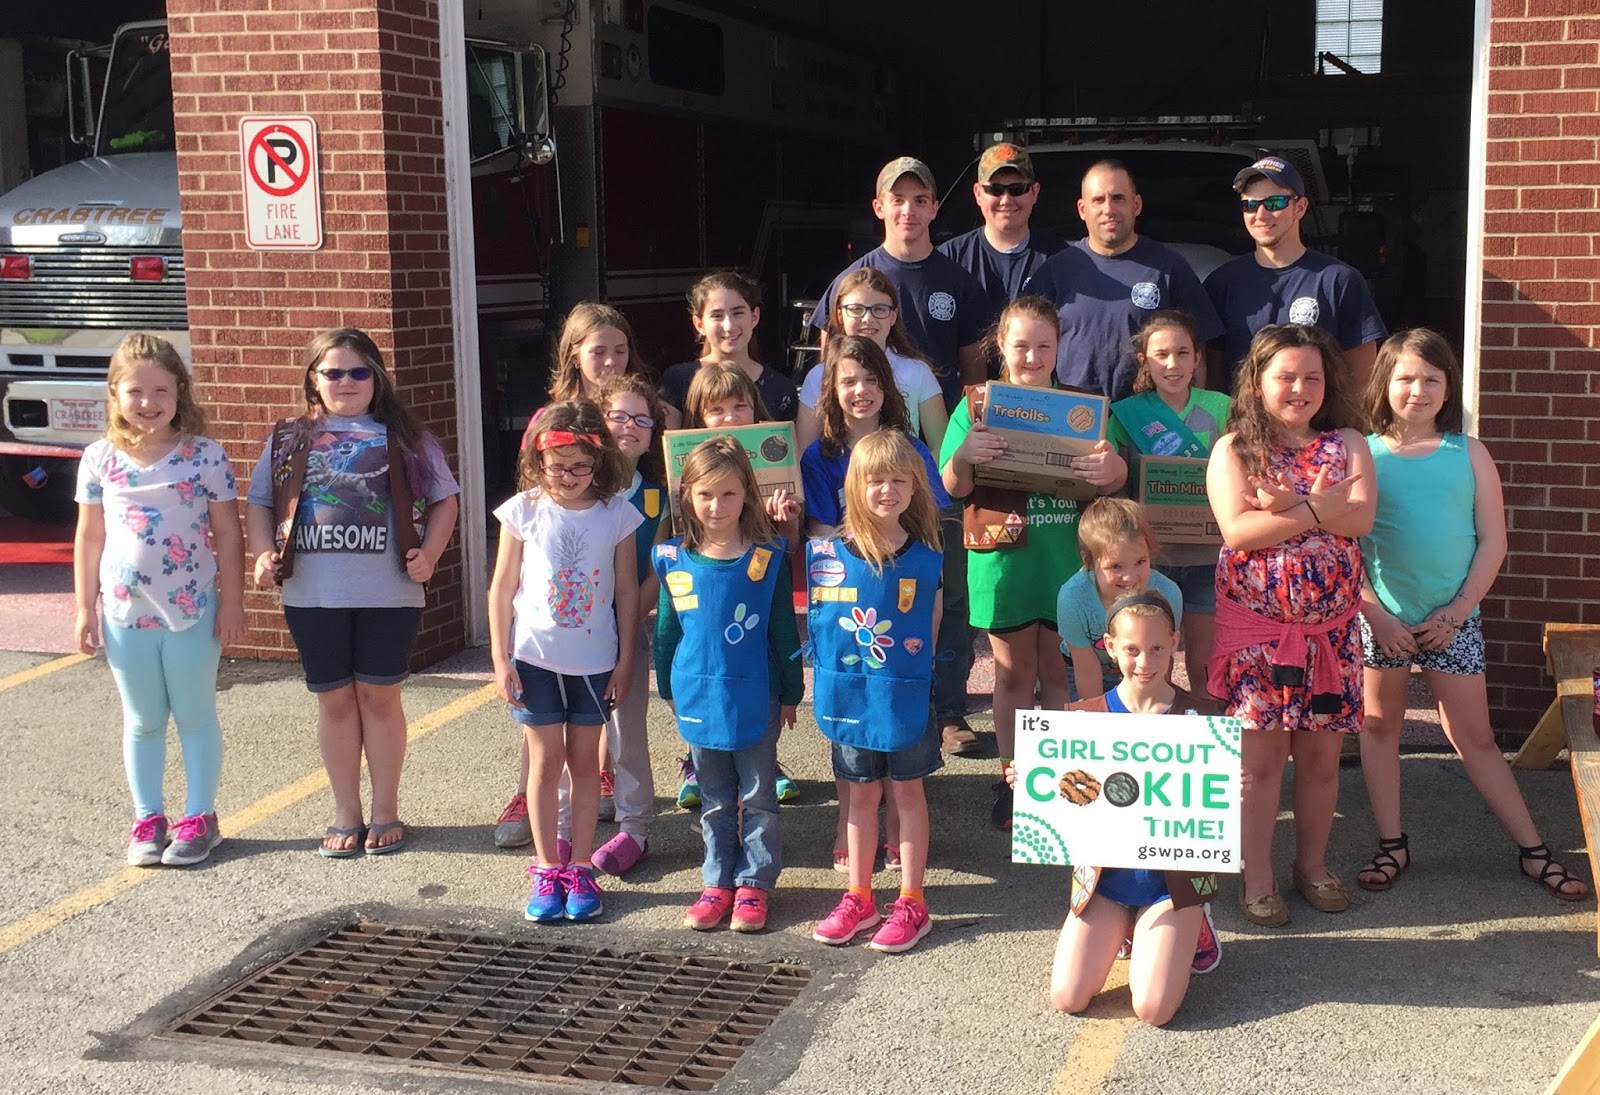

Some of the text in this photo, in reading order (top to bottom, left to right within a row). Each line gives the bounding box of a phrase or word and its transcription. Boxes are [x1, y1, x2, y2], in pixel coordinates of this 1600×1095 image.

[12, 207, 171, 225] CRABTREE
[266, 203, 298, 219] FIRE
[265, 224, 301, 240] LANE
[54, 409, 104, 421] CRABTREE
[991, 404, 1046, 423] Trefoils
[1148, 481, 1208, 496] Thin Min
[296, 525, 387, 550] AWESOME
[1022, 715, 1050, 732] it's
[1038, 738, 1216, 764] GIRL SCOUT
[1143, 816, 1225, 840] TIME!
[1138, 845, 1231, 863] gswpa.org
